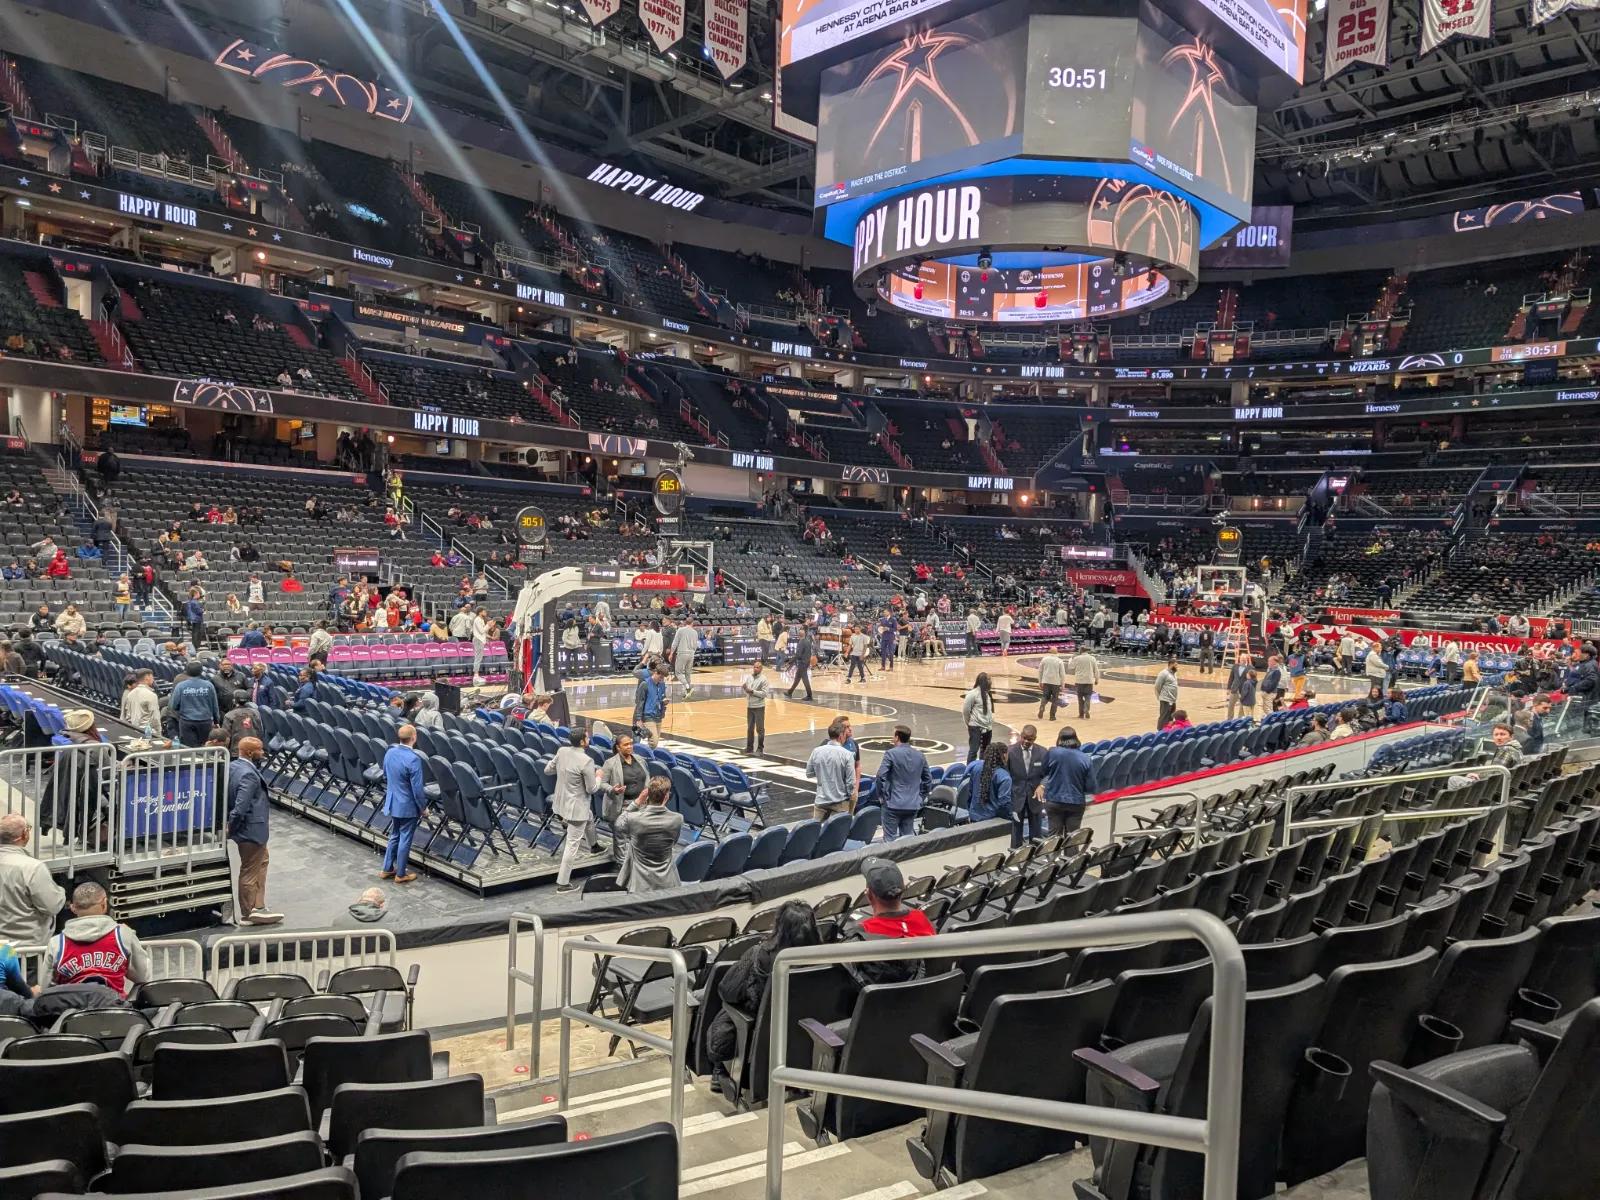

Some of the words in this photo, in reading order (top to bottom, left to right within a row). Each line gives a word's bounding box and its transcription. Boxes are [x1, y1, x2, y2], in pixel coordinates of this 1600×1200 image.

[643, 1, 680, 25] CHAMPIONS
[714, 12, 738, 32] EASTERN
[815, 10, 863, 35] HENNESSY
[863, 2, 885, 16] CITY
[843, 24, 854, 34] AT
[855, 13, 887, 30] ARENA
[889, 3, 911, 20] BAR
[647, 18, 676, 41] 1977-78
[708, 20, 744, 44] CONFERENCE
[1337, 7, 1377, 48] 25
[1438, 15, 1475, 33] UNSELD
[709, 31, 742, 53] CHAMPIONS
[712, 47, 740, 67] 1978-79
[1335, 42, 1376, 61] JOHNSON
[1048, 66, 1107, 90] 30:51
[587, 163, 654, 197] HAPPY
[649, 184, 704, 211] HOUR
[850, 176, 865, 188] MADE
[864, 174, 875, 185] FOR
[874, 172, 883, 182] THE
[119, 193, 159, 219] HAPPY
[165, 204, 197, 227] HOUR
[896, 185, 981, 251] HOUR
[1236, 225, 1277, 248] HOUR
[353, 248, 394, 268] Hennessy
[516, 283, 543, 303] HAPPY
[544, 290, 565, 307] HOUR
[959, 309, 974, 317] 30:51
[663, 318, 690, 333] Hennessy
[771, 340, 793, 356] HAPPY
[794, 344, 812, 358] HOUR
[1525, 344, 1558, 356] 30:51
[900, 358, 928, 371] Hennessy
[1349, 362, 1391, 373] WIZARDS
[1454, 353, 1463, 364] 0
[1021, 365, 1044, 377] HAPPY
[1046, 366, 1064, 378] HOUR
[1151, 371, 1174, 379] $1,890
[1557, 391, 1599, 401] Hennessy
[1128, 409, 1160, 418] Hennessy
[1235, 408, 1260, 419] HAPPY
[1262, 407, 1283, 418] HOUR
[1365, 403, 1400, 414] Hennessy
[414, 412, 449, 434] HAPPY
[452, 417, 479, 436] HOUR
[732, 452, 754, 469] HAPPY
[756, 456, 774, 470] HOUR
[968, 476, 992, 488] HAPPY
[994, 477, 1013, 489] HOUR
[1076, 572, 1108, 582] Hennessy
[1108, 574, 1125, 583] Lofts
[741, 645, 763, 654] Hennes
[57, 951, 125, 978] WEBBER
